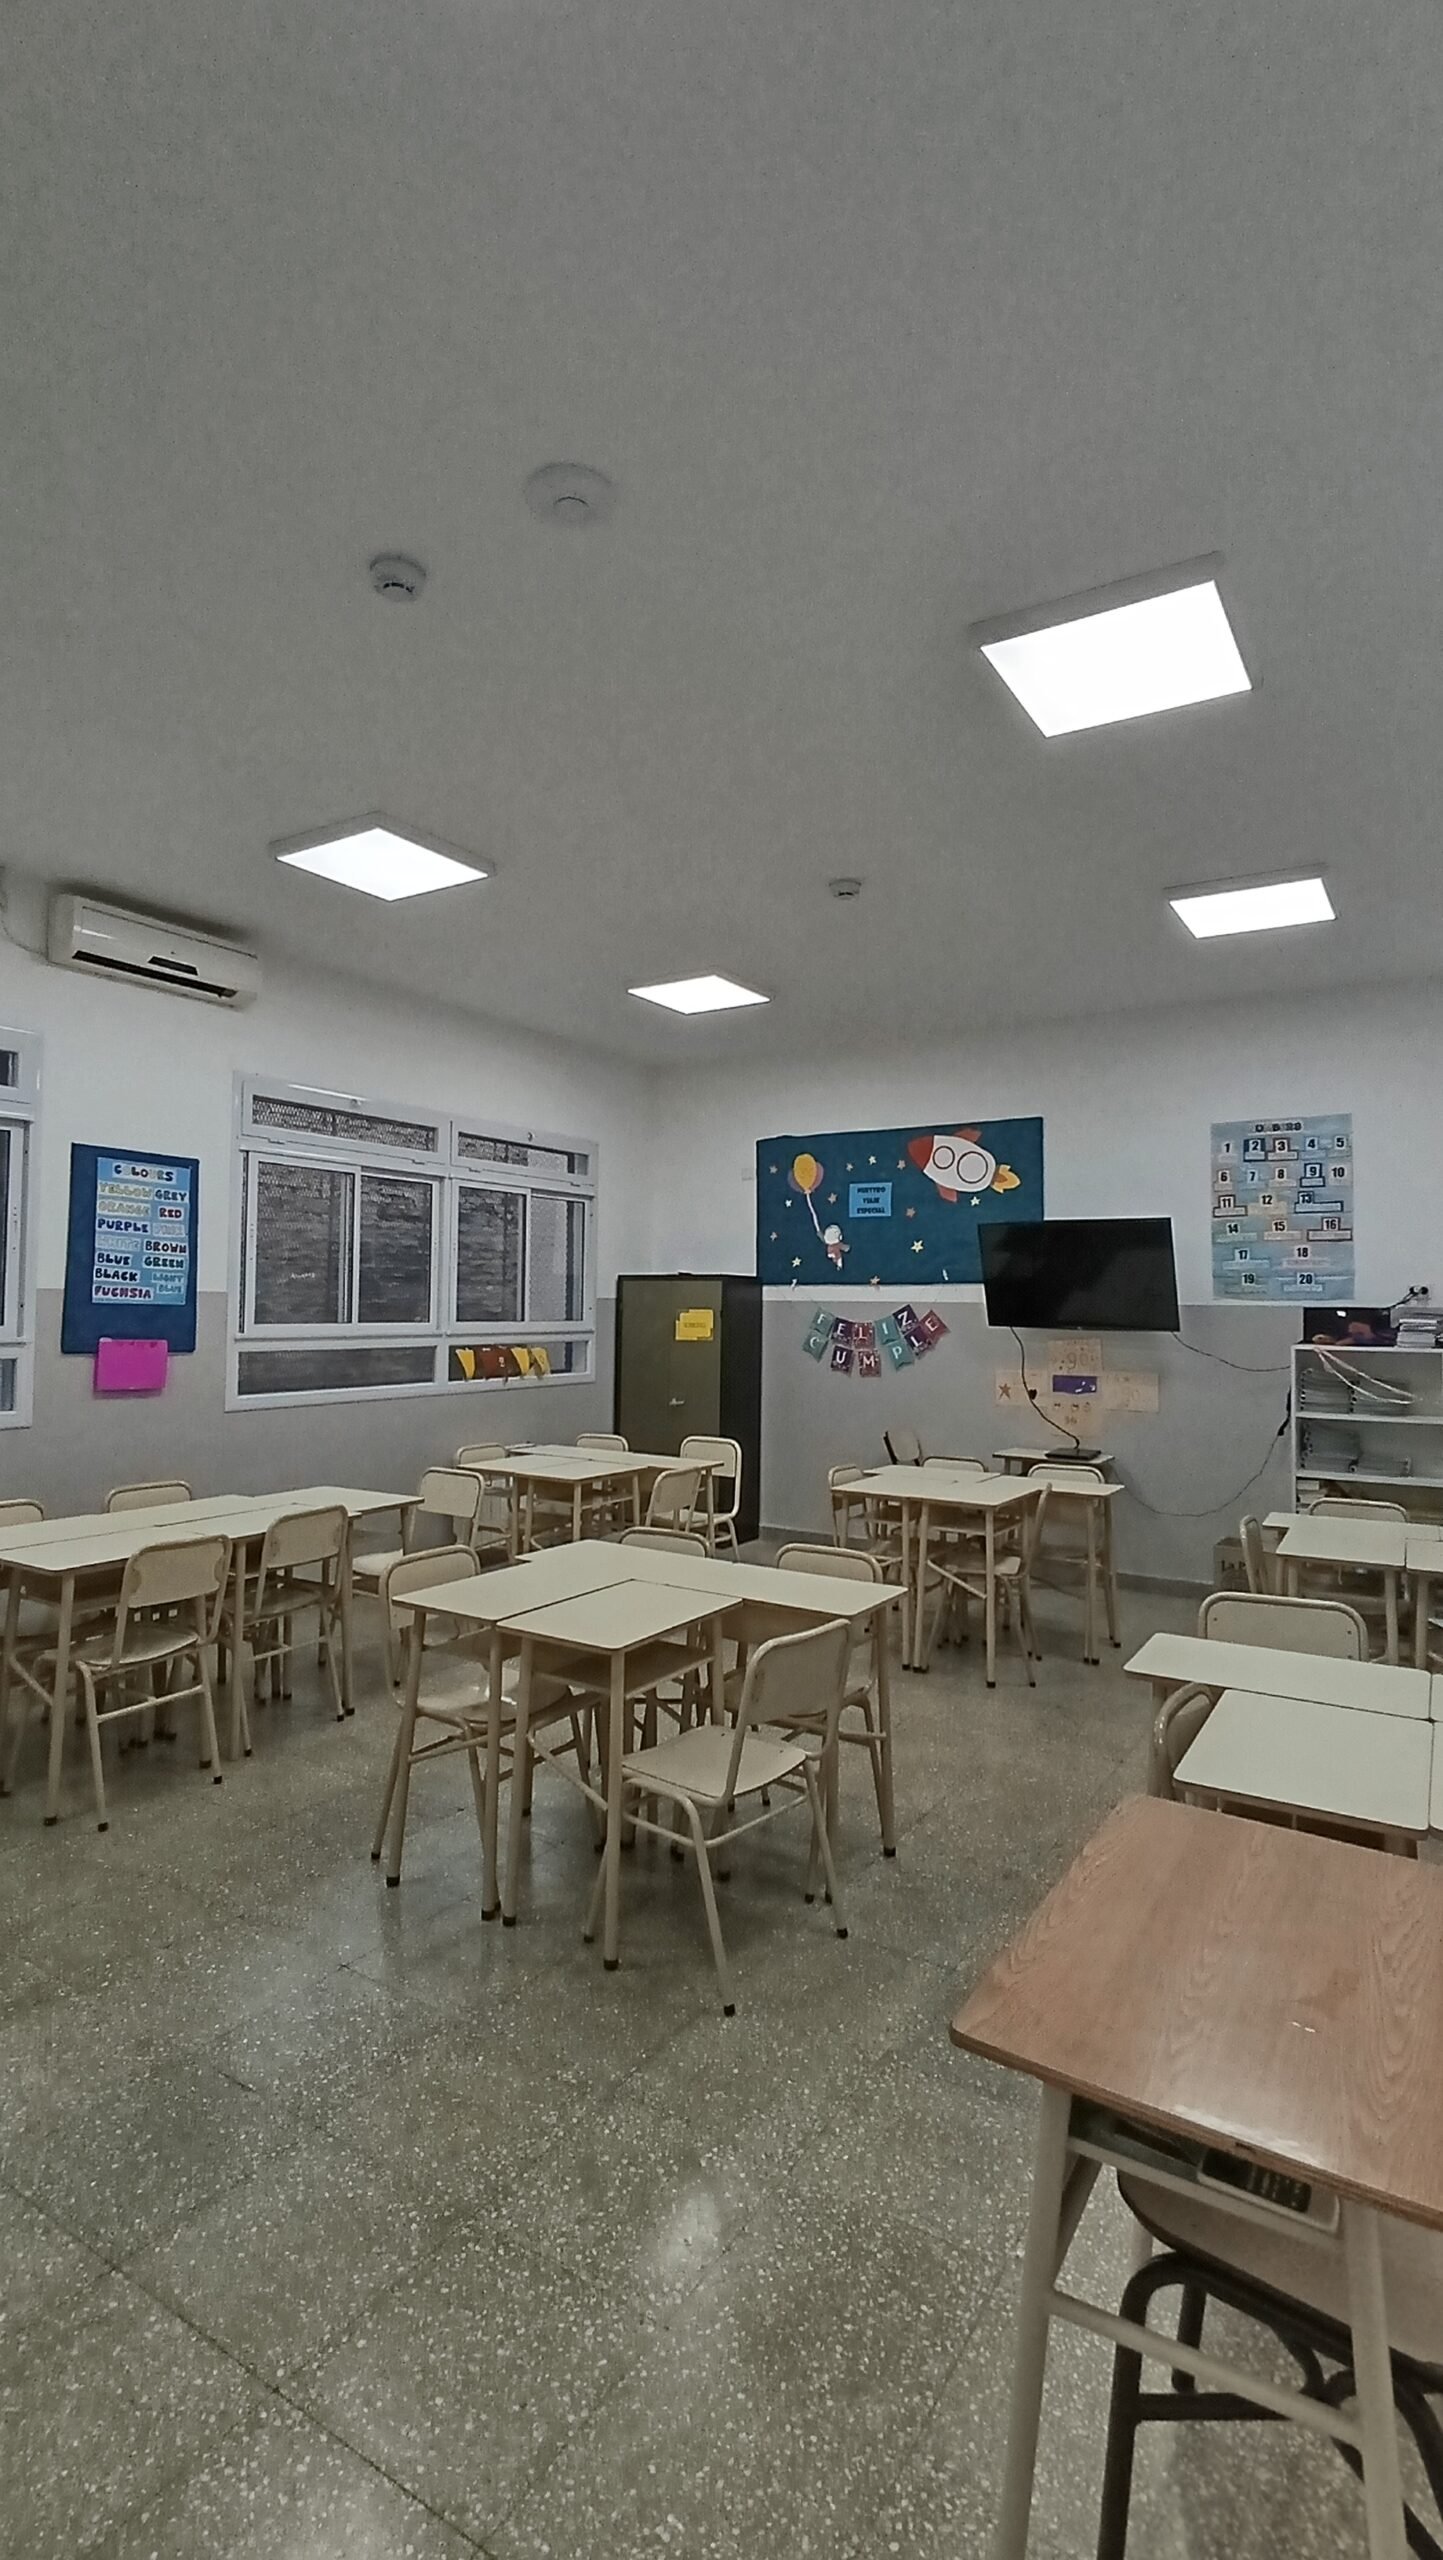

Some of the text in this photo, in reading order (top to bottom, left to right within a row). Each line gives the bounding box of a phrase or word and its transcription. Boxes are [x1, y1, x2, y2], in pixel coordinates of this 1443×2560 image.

[1224, 1137, 1345, 1153] 1 2 3 4 5
[114, 1165, 174, 1181] COLOURS
[1220, 1166, 1345, 1182] 6 7 8 9 10
[99, 1182, 187, 1202] YELLOW GREY
[1222, 1194, 1311, 1208] 11 12 13
[98, 1200, 182, 1218] ORANGE RED
[97, 1218, 149, 1233] PURPLE
[1228, 1220, 1336, 1234] 14 15 16
[145, 1240, 187, 1254] BROWN
[1238, 1247, 1309, 1260] 17 18
[97, 1252, 184, 1269] BLUE GREEN
[95, 1268, 139, 1282] BLACK
[1243, 1274, 1313, 1284] 19 20
[94, 1285, 152, 1300] FUCHSIA
